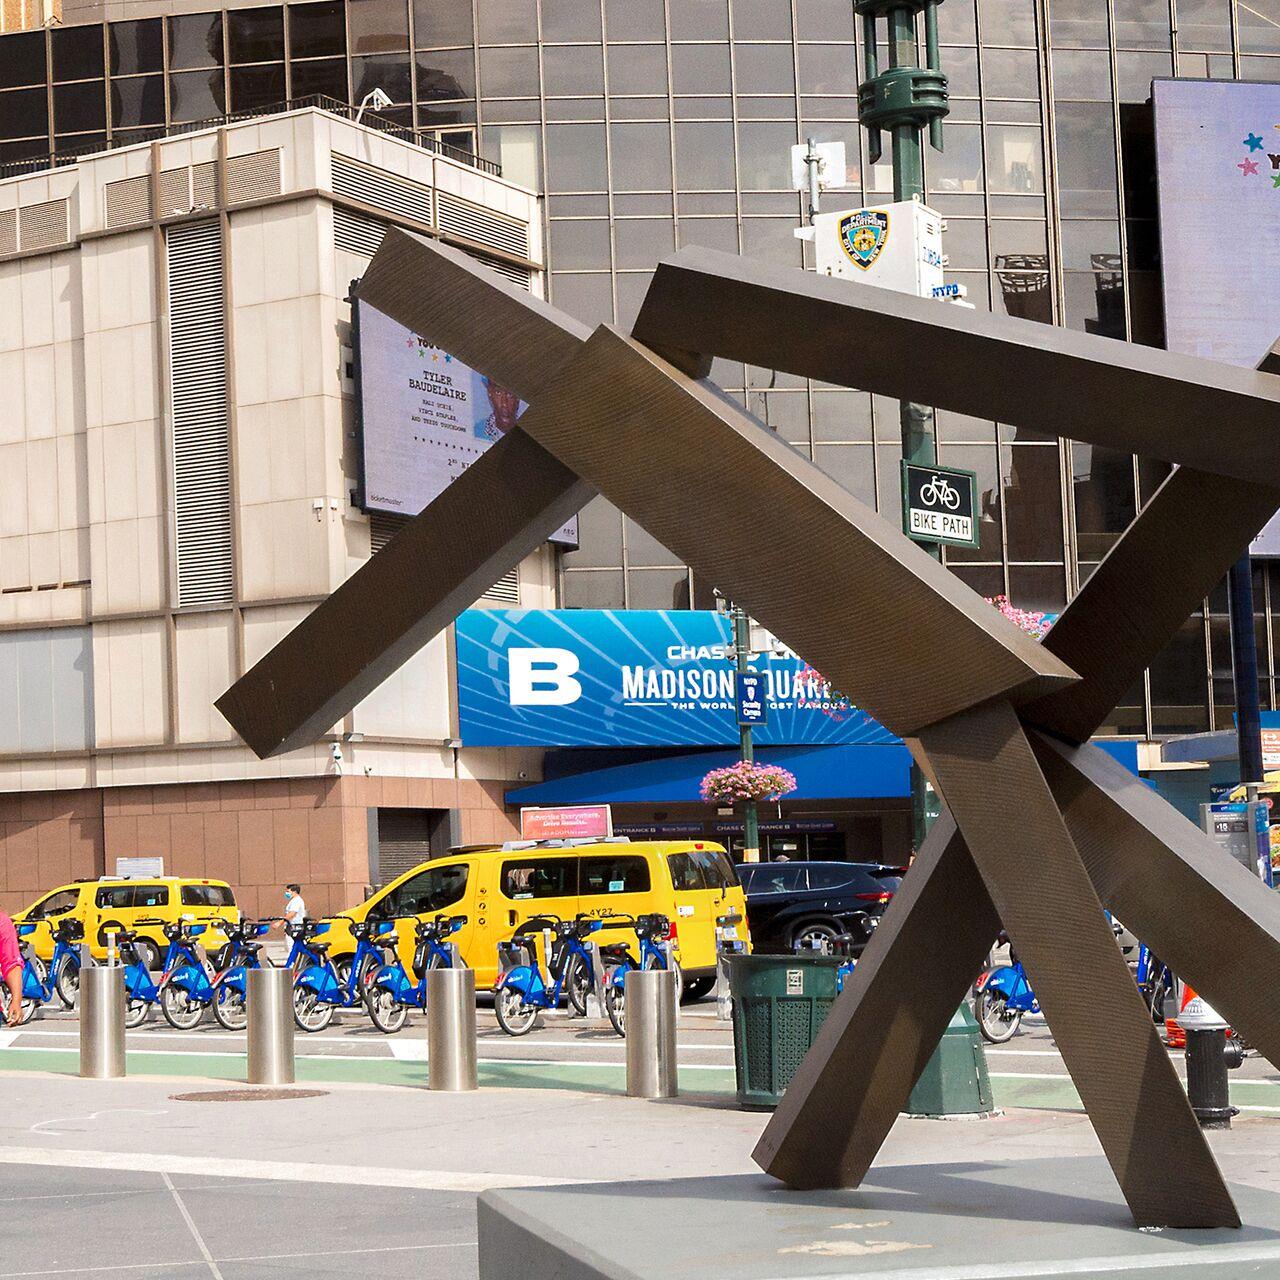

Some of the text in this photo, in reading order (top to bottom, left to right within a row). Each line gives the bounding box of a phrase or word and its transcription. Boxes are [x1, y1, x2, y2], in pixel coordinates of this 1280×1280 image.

[932, 284, 959, 297] NYPD
[423, 370, 453, 386] TYLER
[408, 379, 467, 401] BAUDELAIRE
[913, 512, 969, 535] BIKE PATH
[667, 646, 728, 660] CHAS
[508, 647, 582, 706] B
[622, 665, 735, 699] MADISON
[700, 702, 736, 710] WORL
[589, 908, 613, 916] 4Y27
